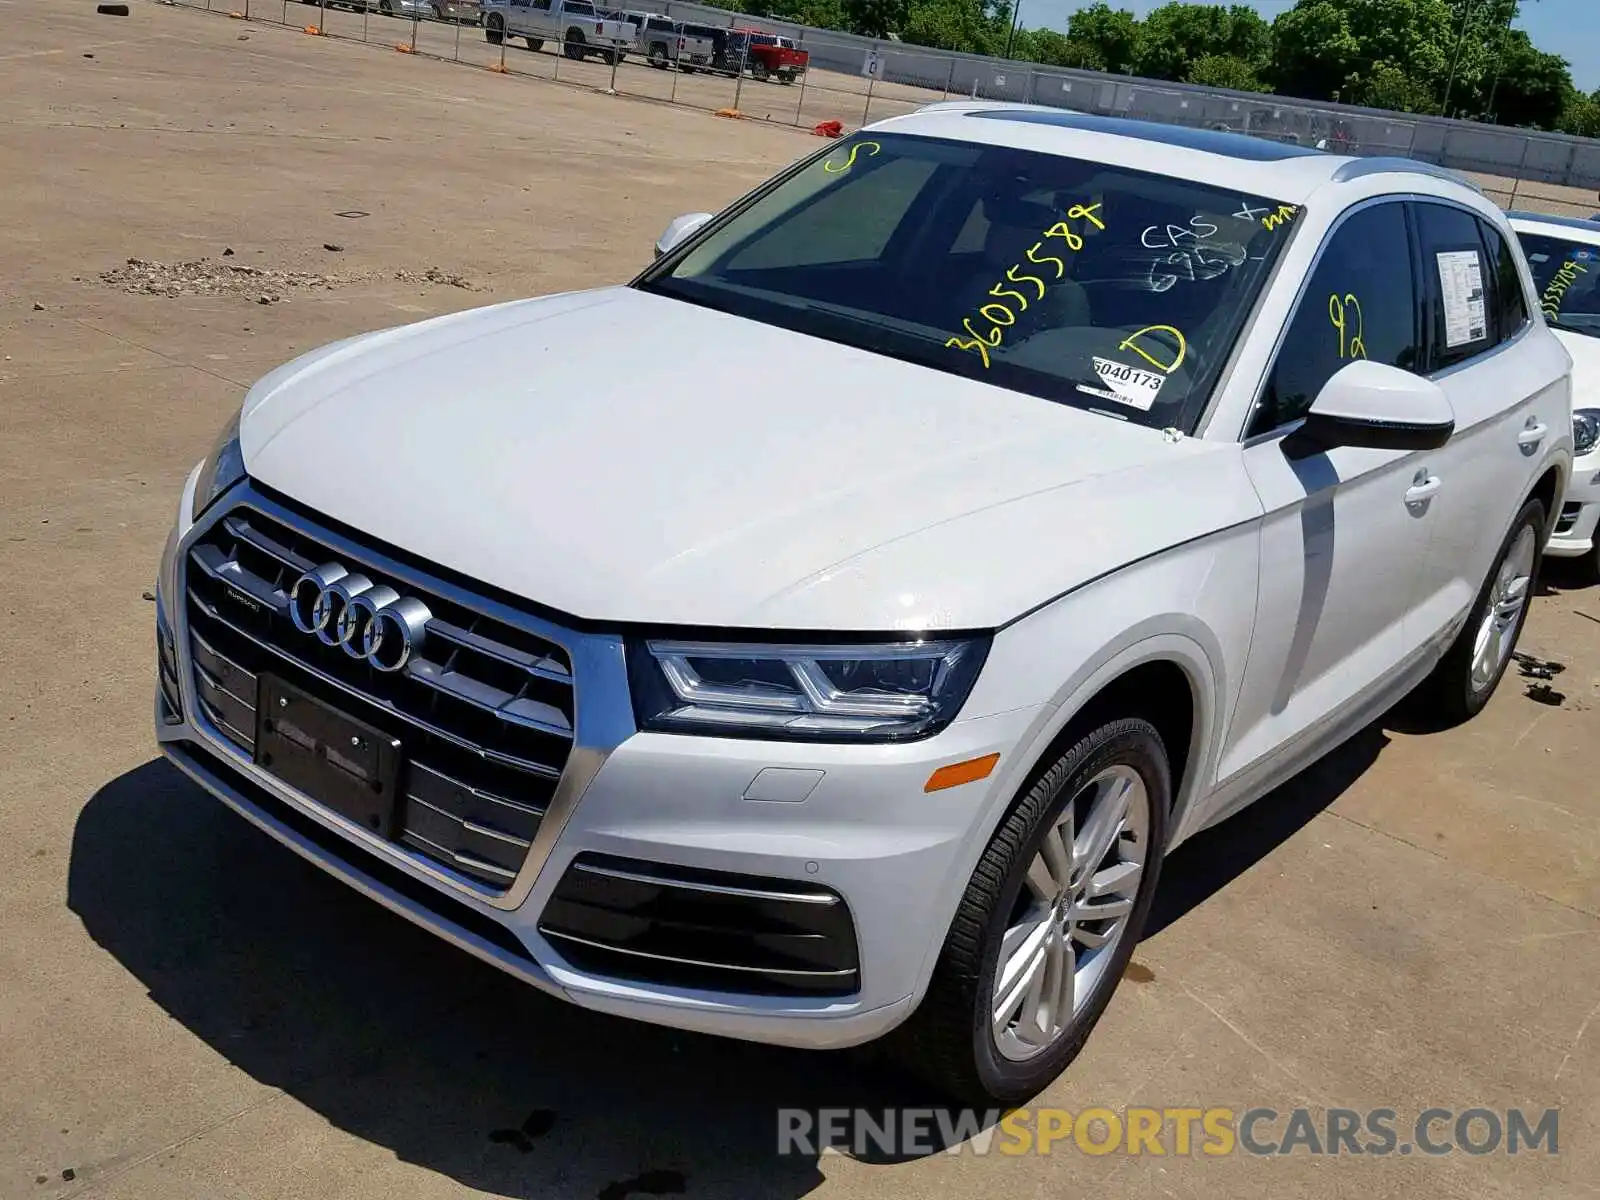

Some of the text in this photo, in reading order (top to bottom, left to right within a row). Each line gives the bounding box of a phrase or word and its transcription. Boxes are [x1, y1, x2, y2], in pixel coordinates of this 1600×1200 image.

[824, 141, 881, 173] S
[1141, 215, 1218, 248] CAS
[944, 203, 1105, 368] 36055589
[1119, 324, 1186, 374] D
[1329, 293, 1368, 360] 92
